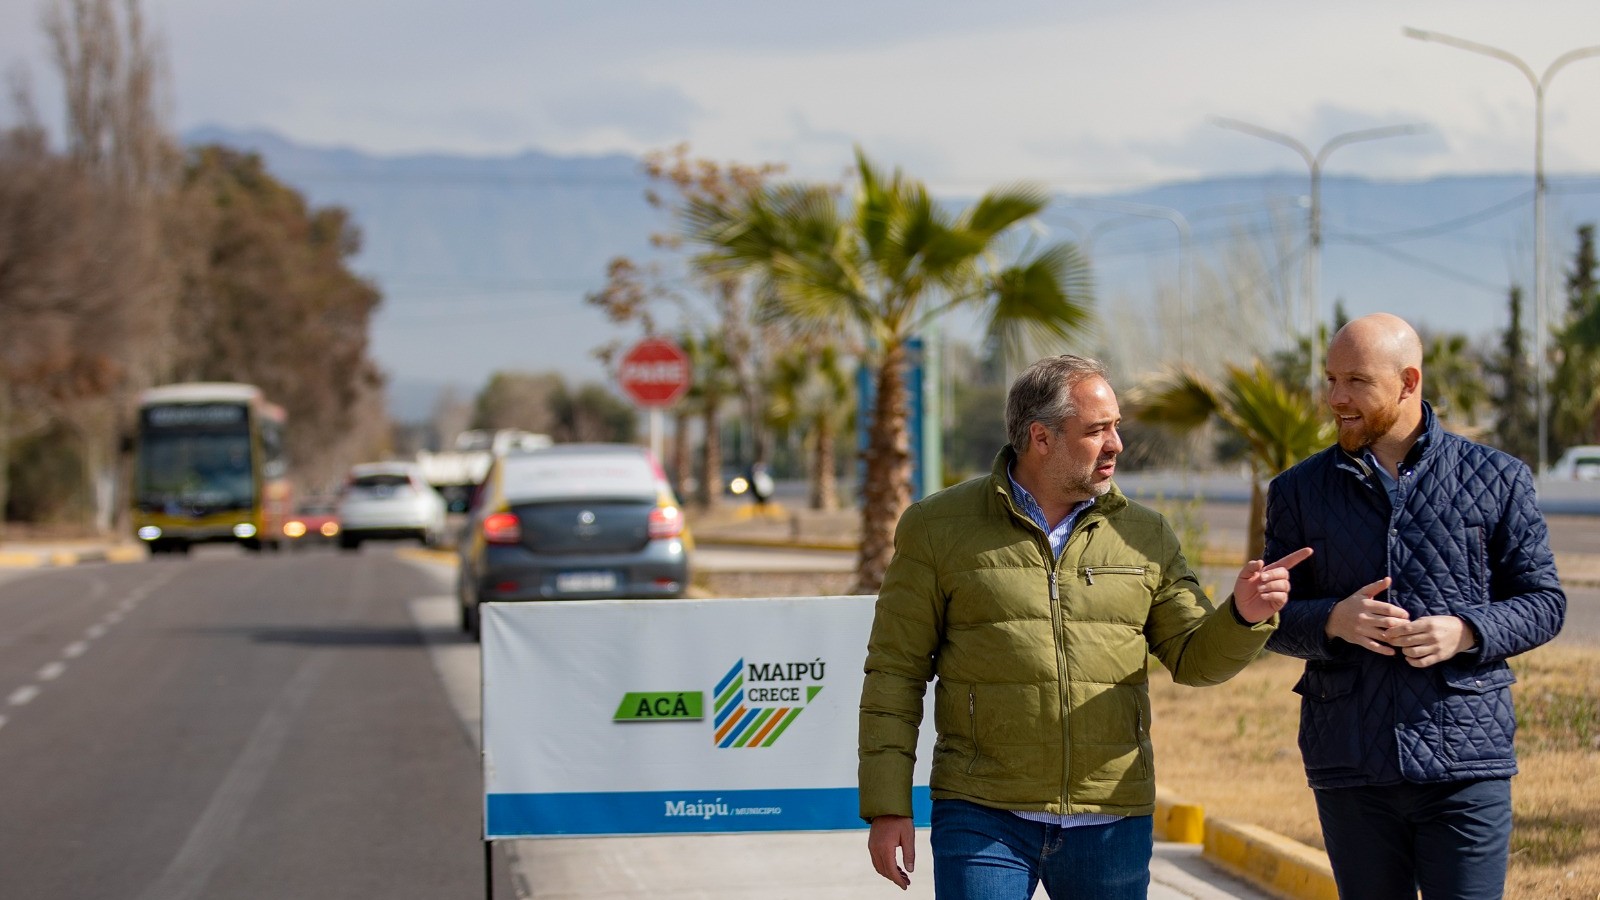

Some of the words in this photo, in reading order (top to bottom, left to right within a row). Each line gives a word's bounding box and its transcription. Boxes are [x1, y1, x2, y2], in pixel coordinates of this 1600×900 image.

[622, 362, 686, 384] PARE
[748, 658, 826, 682] MAIPÚ
[635, 693, 689, 717] ACÁ
[748, 687, 800, 702] CRECE
[664, 798, 728, 820] Maipú
